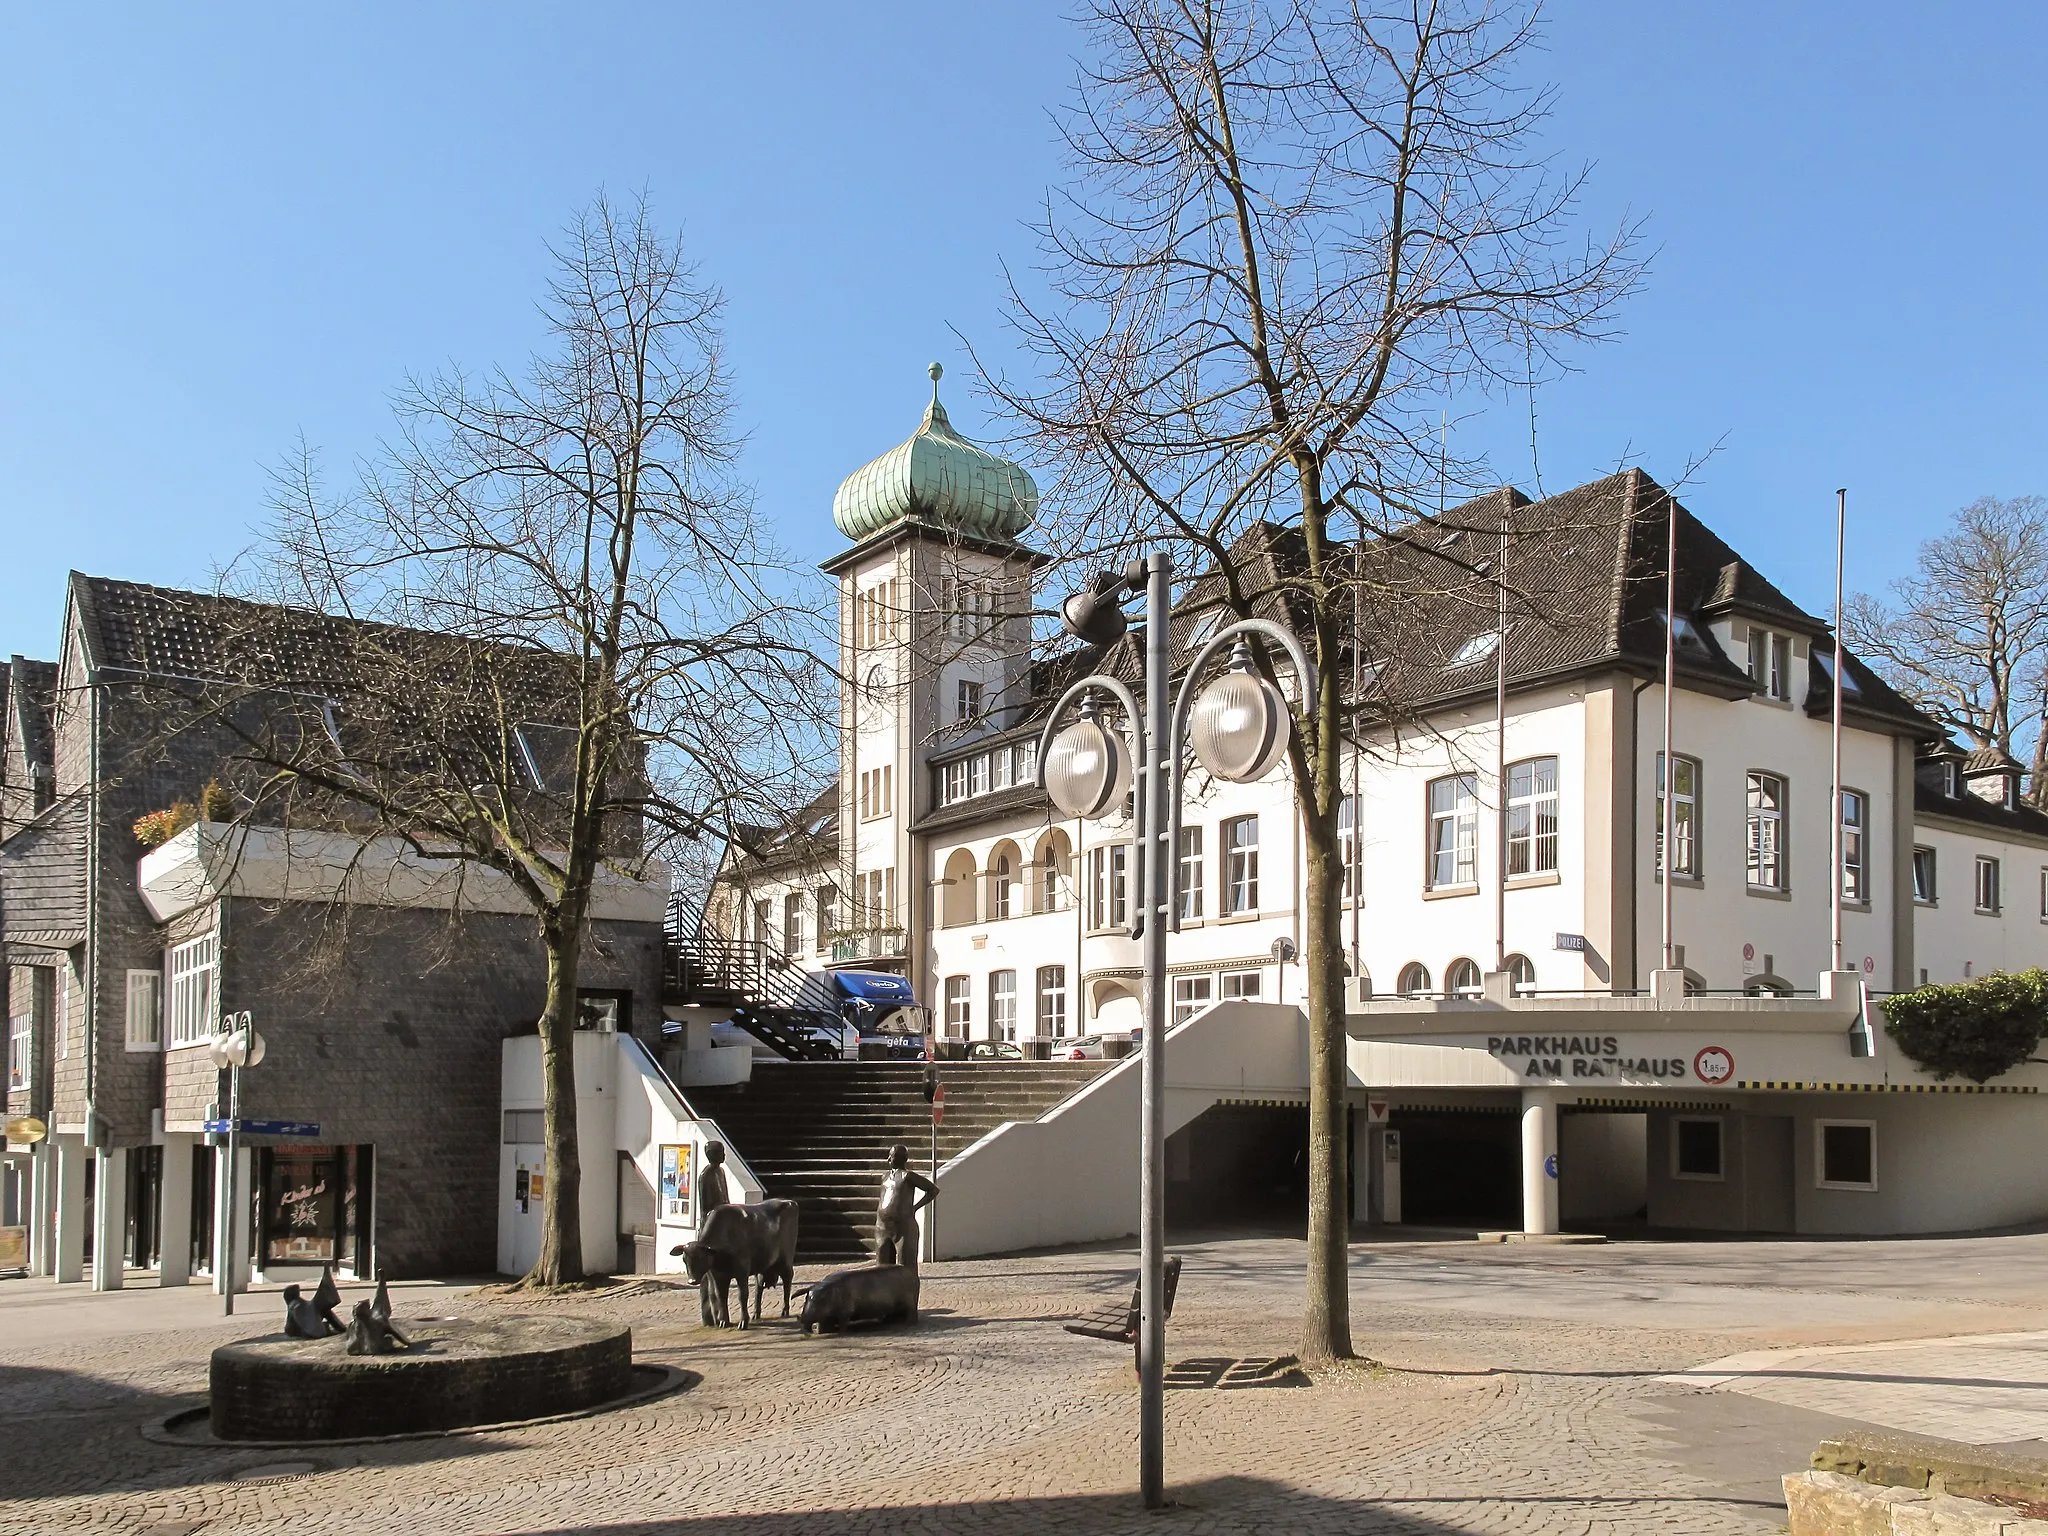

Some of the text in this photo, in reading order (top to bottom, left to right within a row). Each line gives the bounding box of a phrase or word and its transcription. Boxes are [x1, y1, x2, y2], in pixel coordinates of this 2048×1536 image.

[1557, 936, 1584, 949] POLIZEI
[1488, 1037, 1618, 1056] PARKHAUS
[1525, 1058, 1686, 1077] AM RATHAUS
